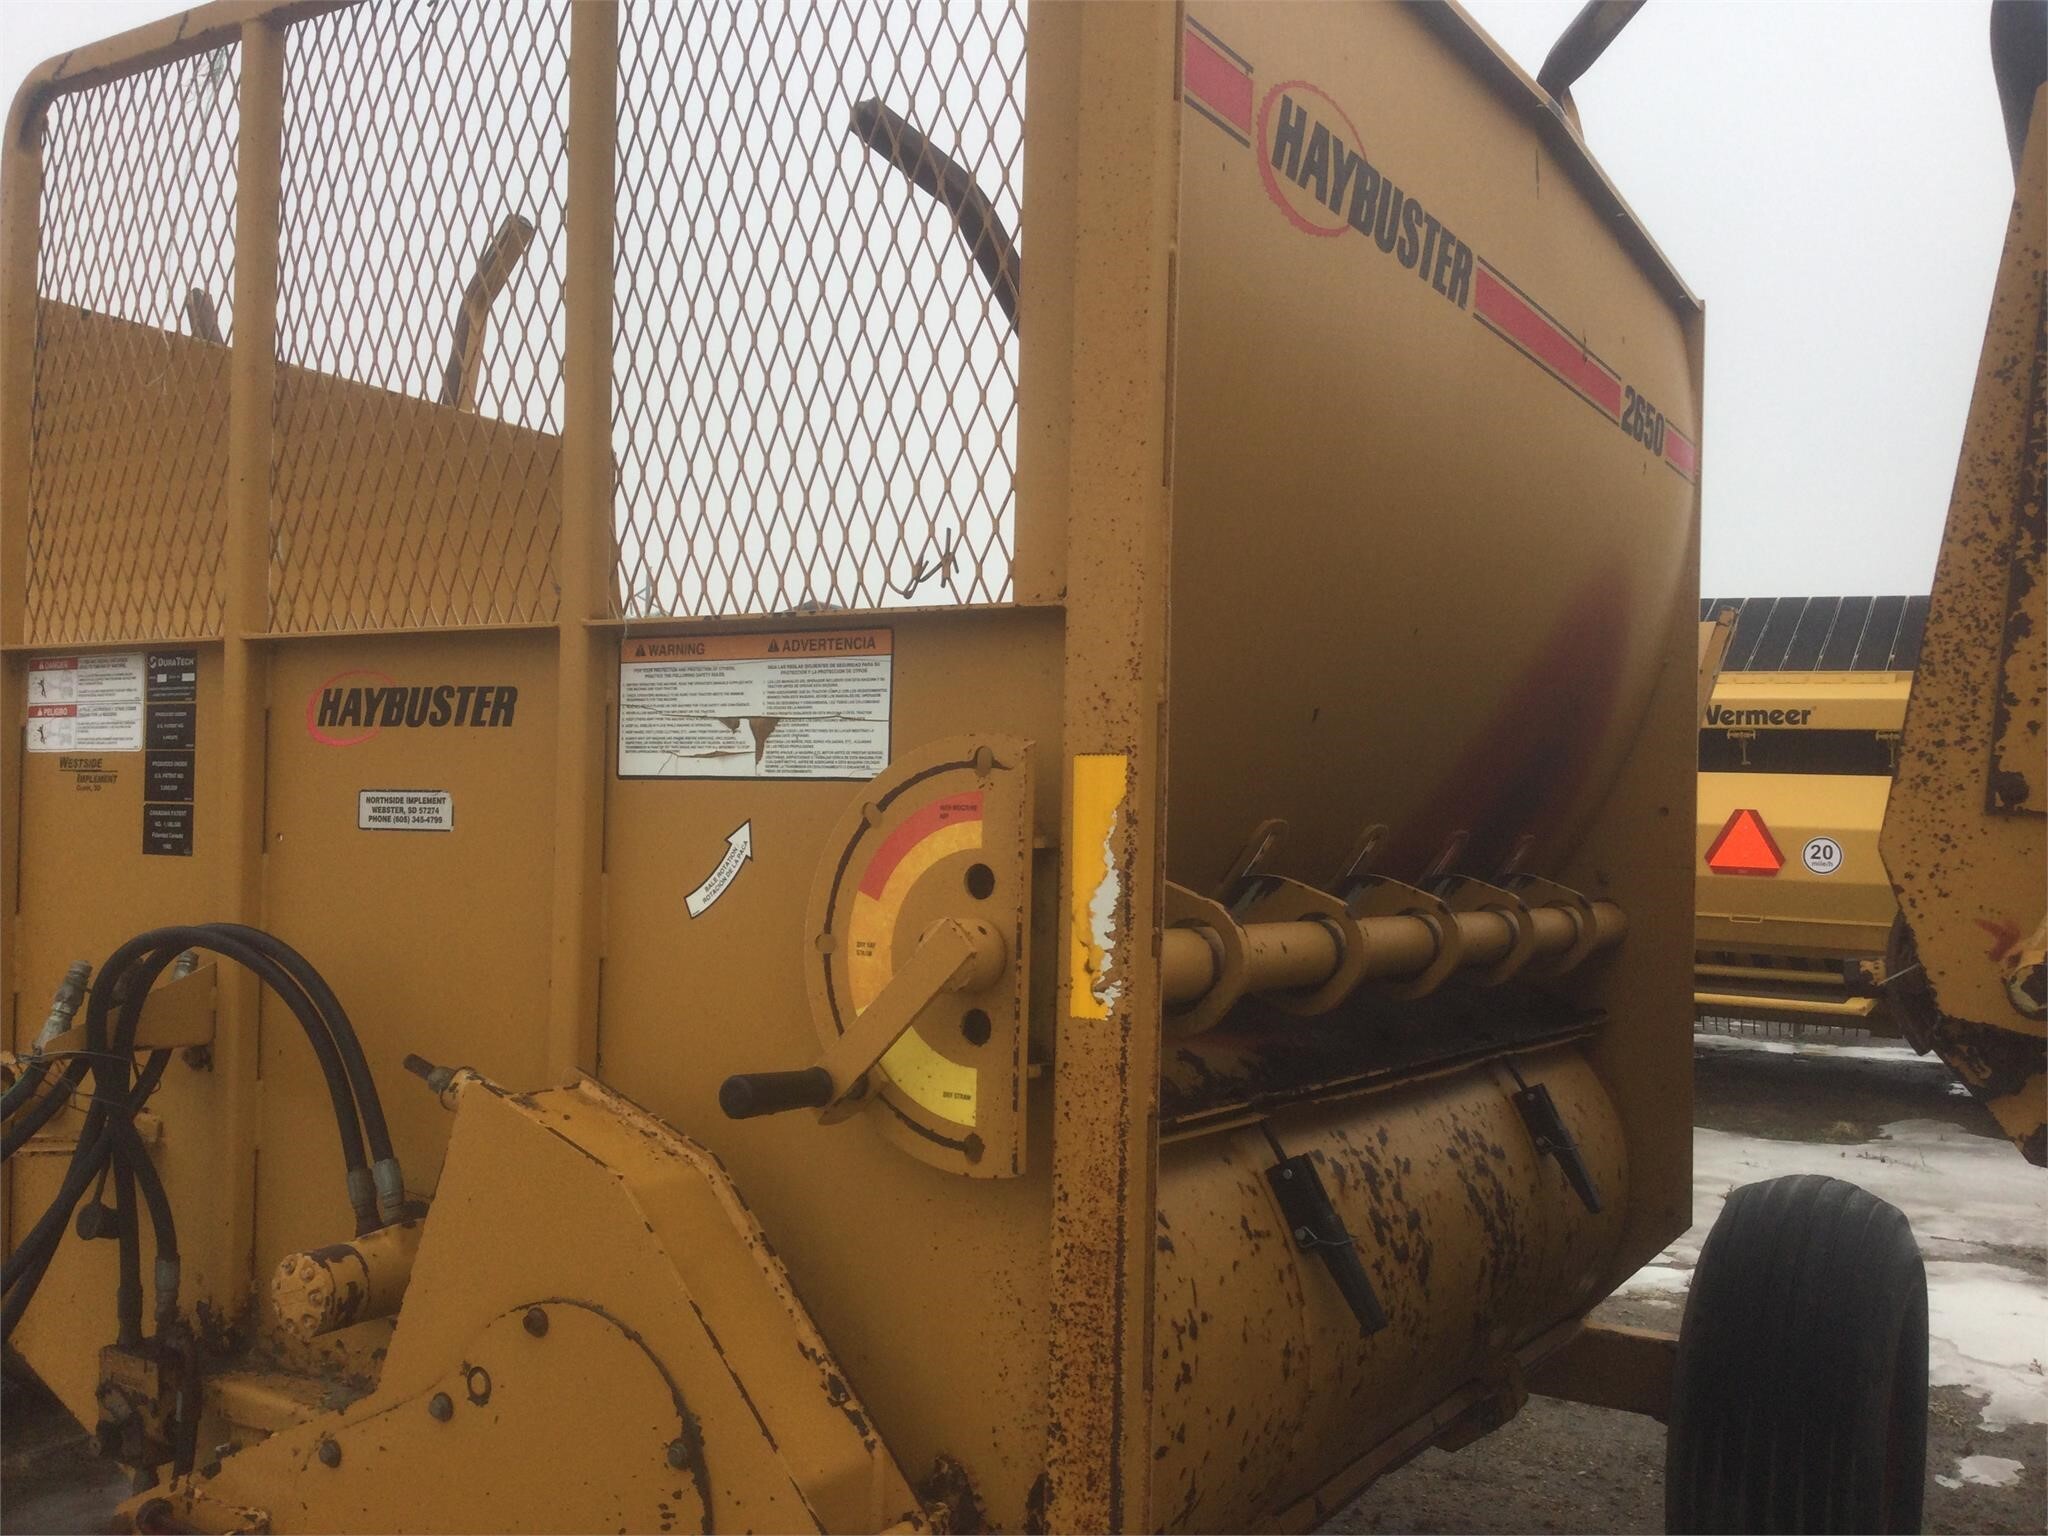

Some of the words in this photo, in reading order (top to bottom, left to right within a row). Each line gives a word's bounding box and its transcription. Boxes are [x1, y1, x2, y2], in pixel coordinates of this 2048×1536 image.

[1271, 94, 1473, 311] HAYBUSTER
[1620, 384, 1665, 456] 2650
[648, 643, 705, 656] WARNING
[782, 636, 876, 652] ADVERTENCIA
[43, 707, 68, 716] PELIGRO
[317, 685, 518, 728] HAYBUSTER
[1706, 705, 1812, 725] Vermeer
[77, 774, 118, 784] IMPLEMENT
[372, 807, 406, 815] WEBSTER,
[393, 816, 410, 824] (605)
[725, 869, 733, 878] DE
[732, 859, 740, 869] LA
[737, 840, 748, 859] PACA
[1810, 845, 1834, 860] 20
[704, 877, 719, 892] BALE
[717, 847, 738, 877] ROTATION
